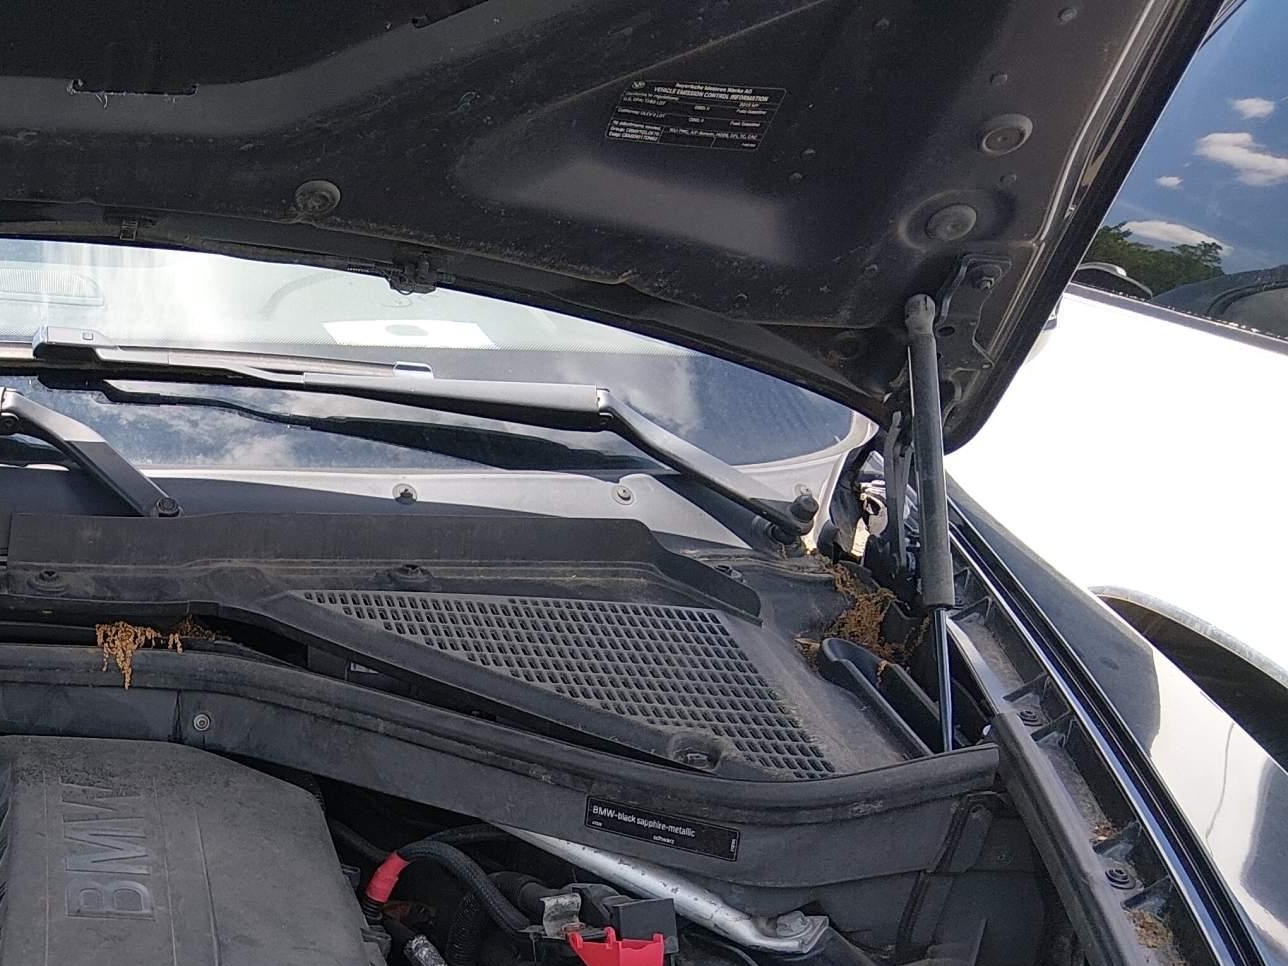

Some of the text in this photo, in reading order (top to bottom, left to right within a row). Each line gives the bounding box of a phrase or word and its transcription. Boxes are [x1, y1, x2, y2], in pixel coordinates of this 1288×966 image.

[703, 92, 729, 100] CONTROL
[729, 94, 769, 102] INFORMATION
[592, 805, 696, 838] BMW-black sapphire-metallic
[61, 775, 156, 919] BMW
